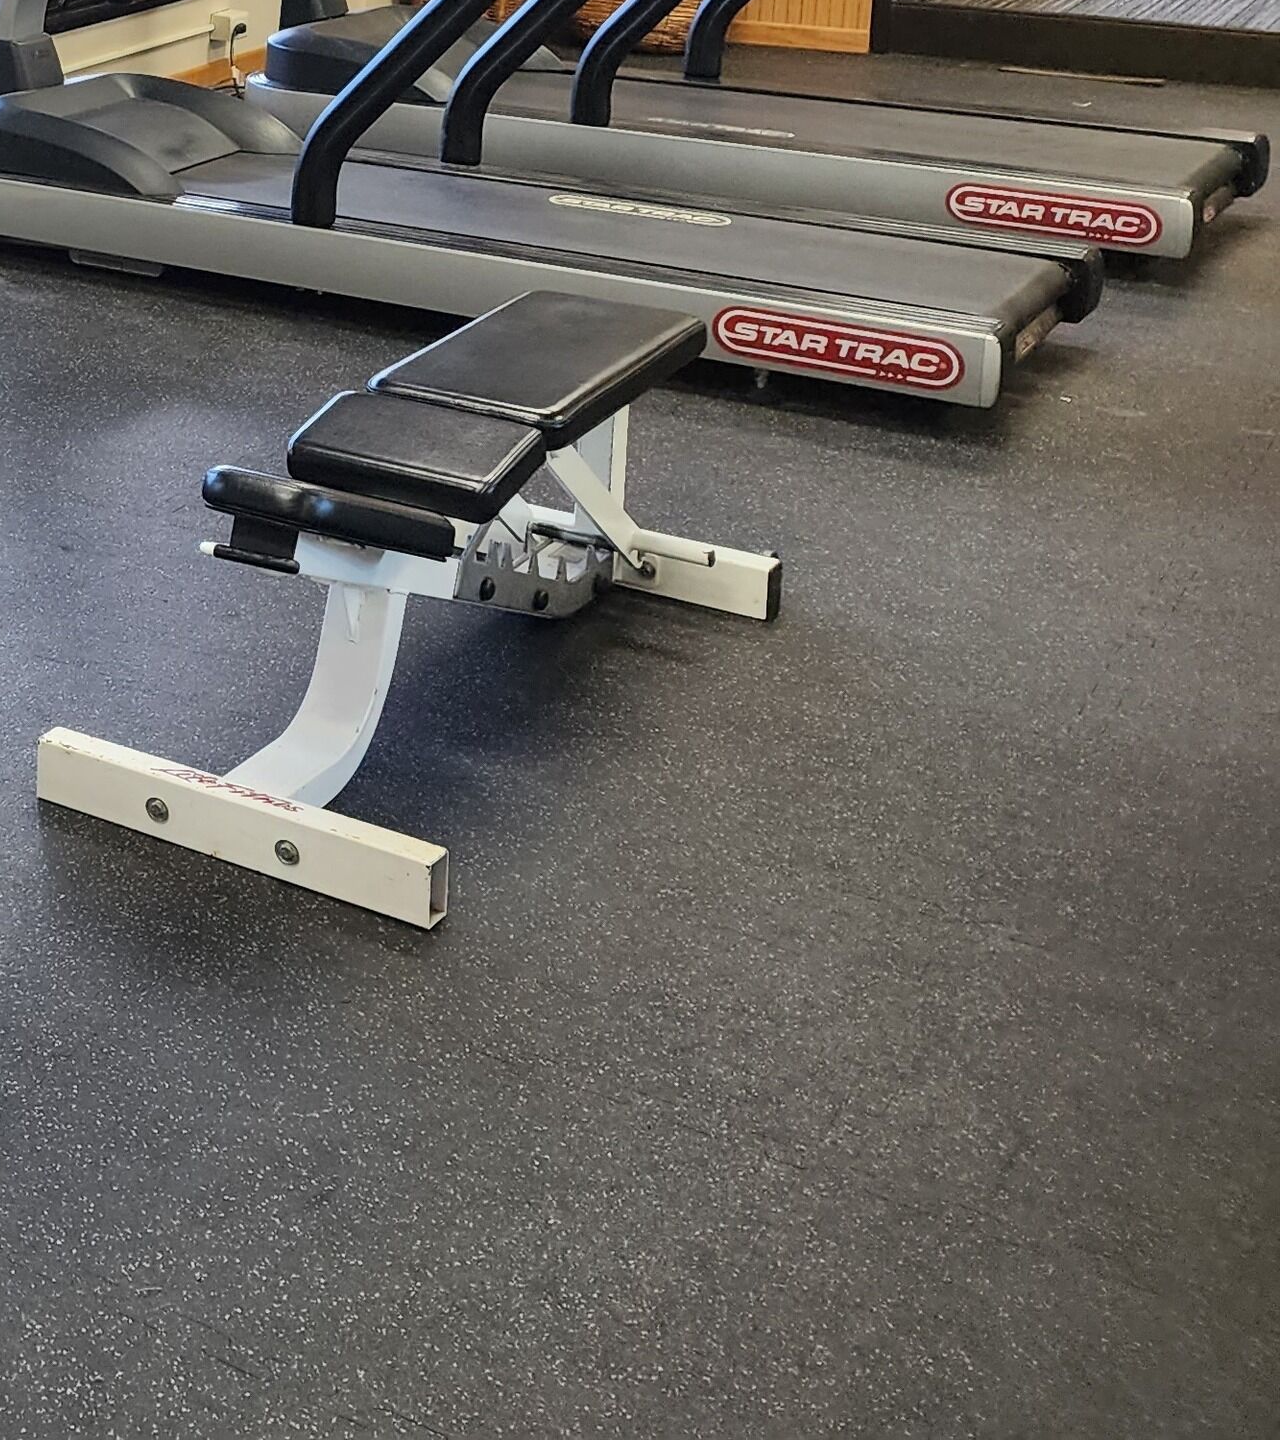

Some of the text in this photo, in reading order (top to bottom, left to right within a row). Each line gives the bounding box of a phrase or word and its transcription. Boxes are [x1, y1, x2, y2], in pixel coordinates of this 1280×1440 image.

[962, 195, 1140, 233] STAR TRAC
[729, 321, 942, 373] STAR TRAC
